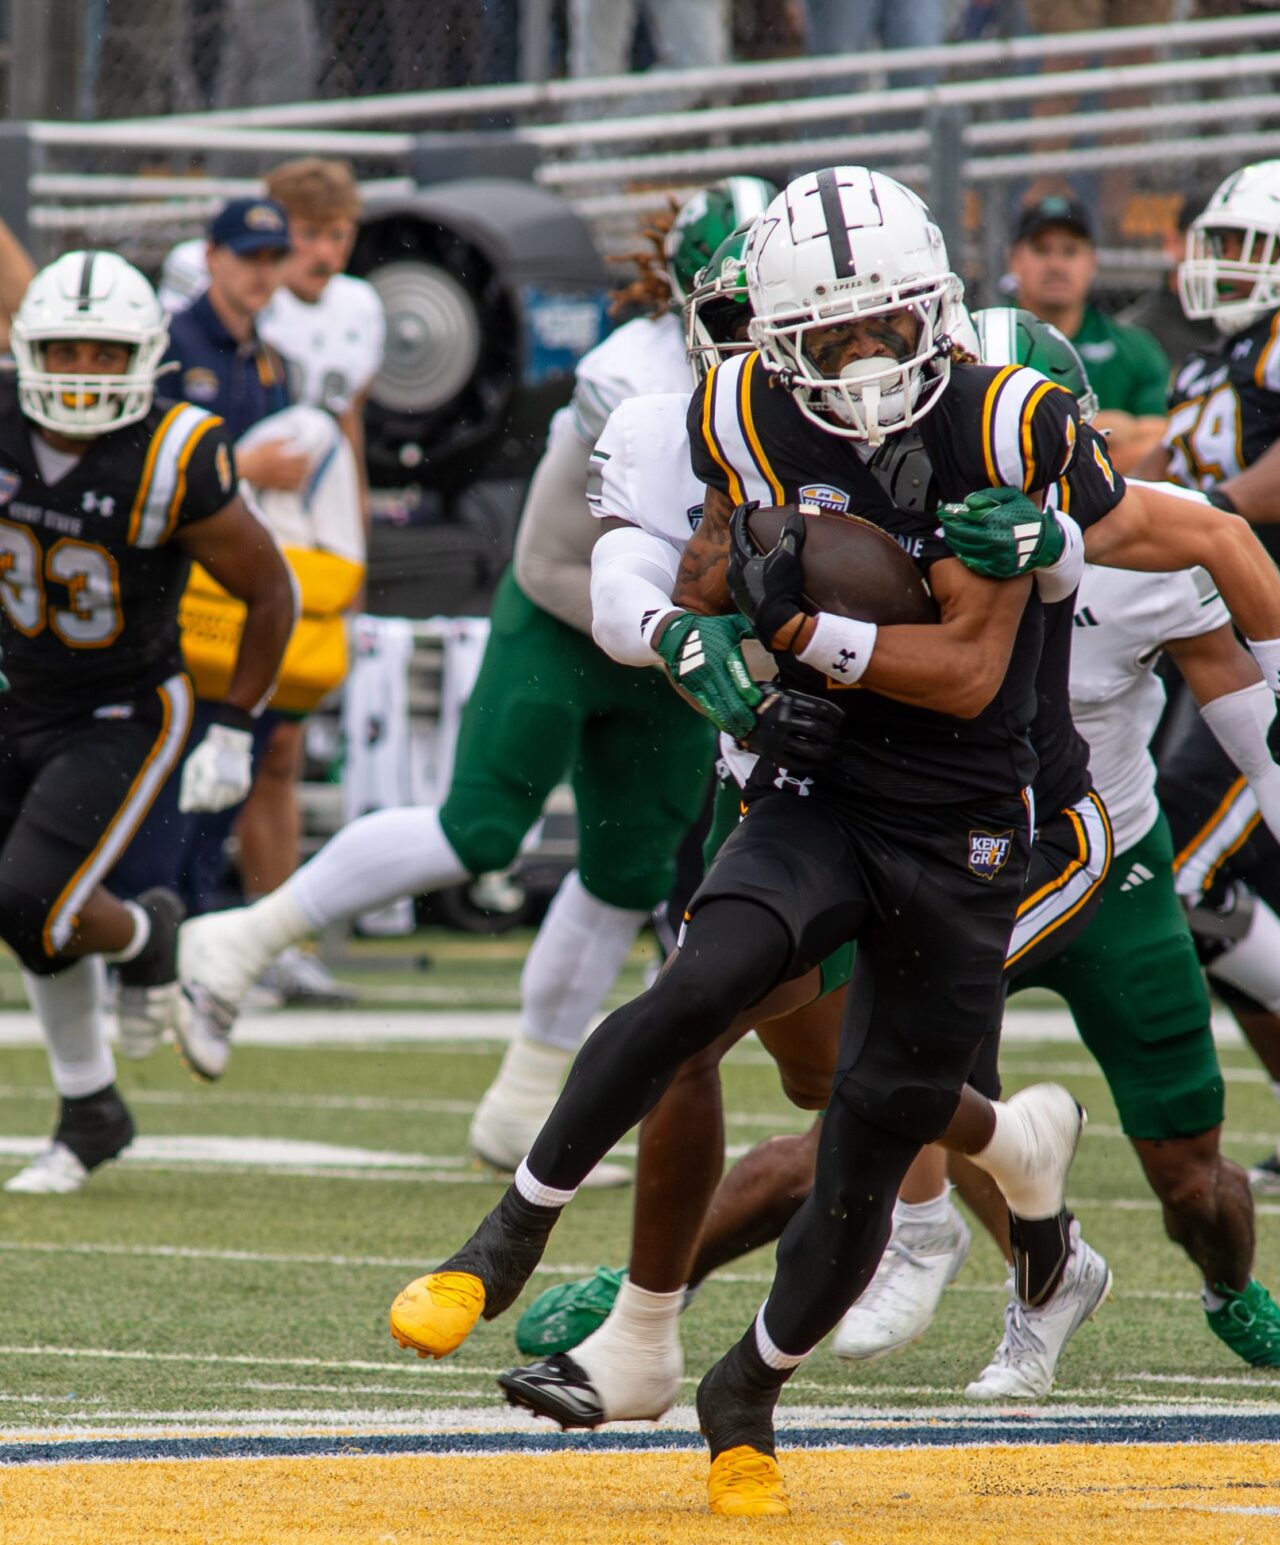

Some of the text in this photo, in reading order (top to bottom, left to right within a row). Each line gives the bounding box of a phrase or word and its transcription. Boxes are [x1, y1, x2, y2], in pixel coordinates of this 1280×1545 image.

[833, 280, 862, 291] SPEED
[0, 516, 125, 650] 33
[971, 837, 1010, 852] KENT
